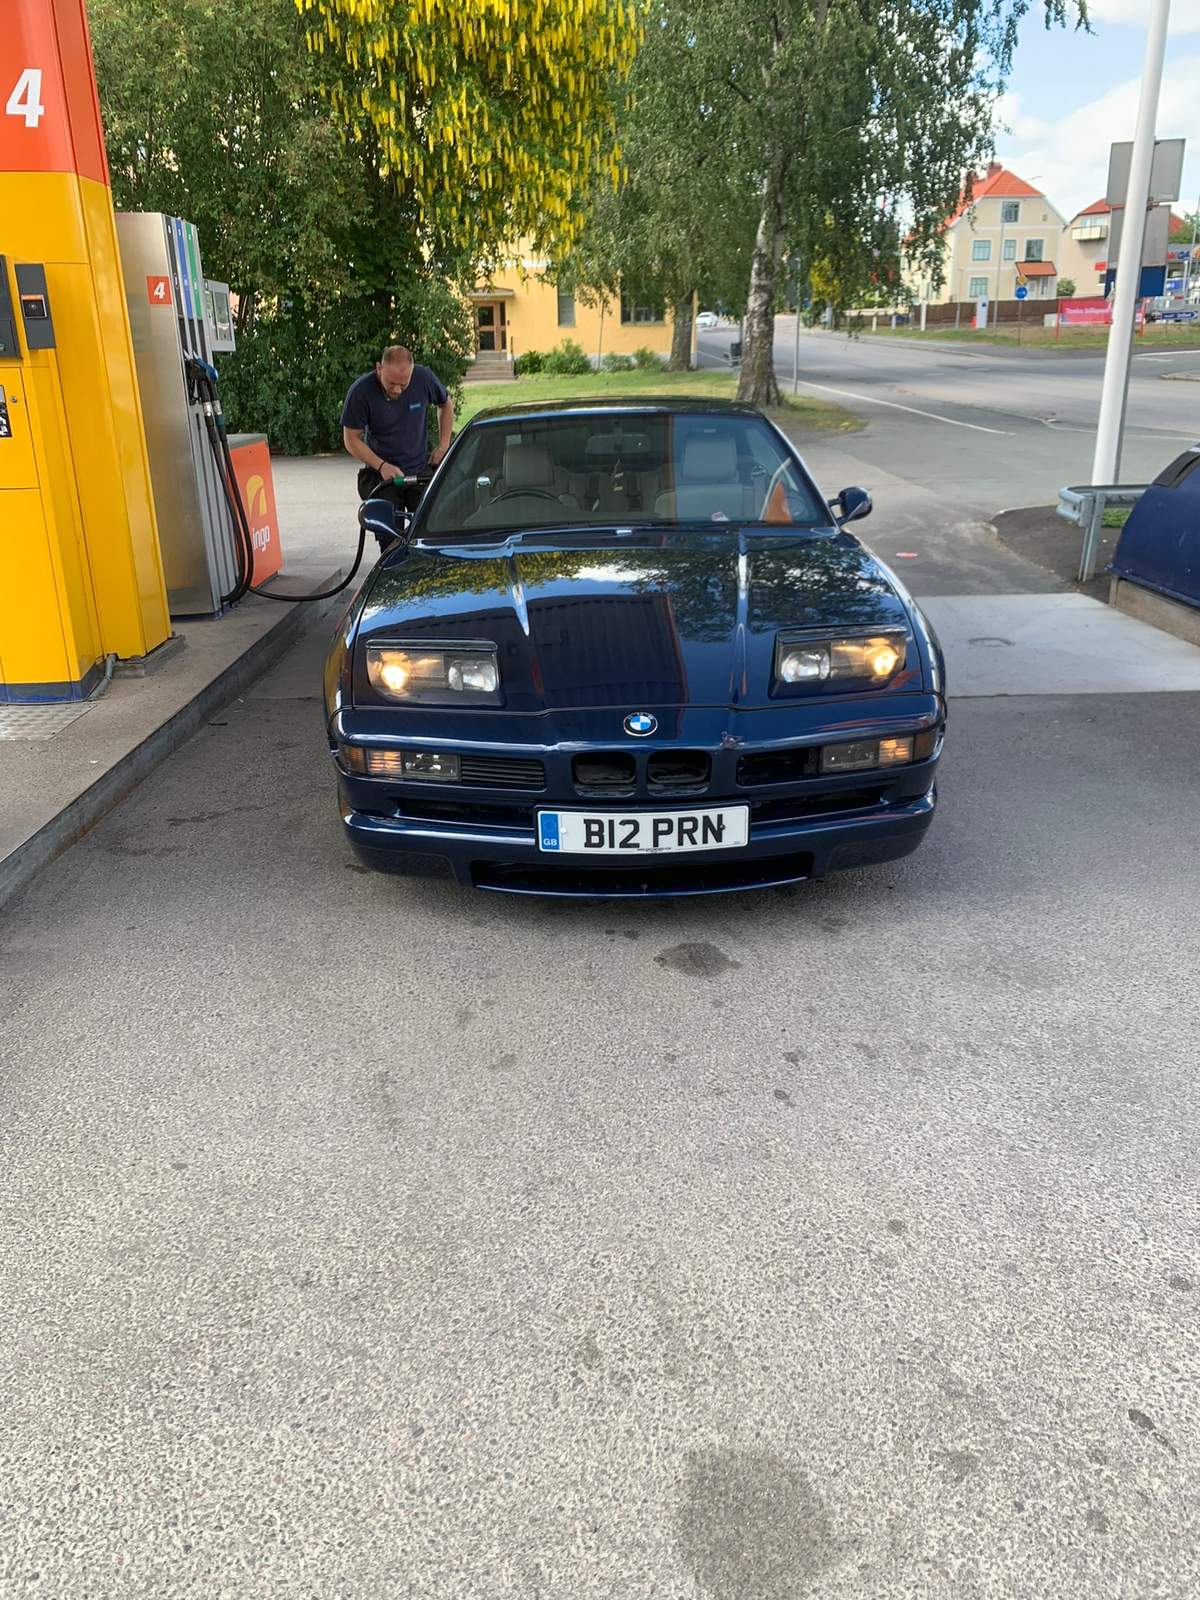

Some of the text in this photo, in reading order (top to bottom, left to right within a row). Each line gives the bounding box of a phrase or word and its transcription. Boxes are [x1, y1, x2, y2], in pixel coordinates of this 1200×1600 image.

[5, 68, 45, 128] 4
[153, 281, 166, 299] 4
[251, 524, 271, 553] ingo
[543, 838, 557, 847] GB
[583, 813, 724, 849] B12 PRN
